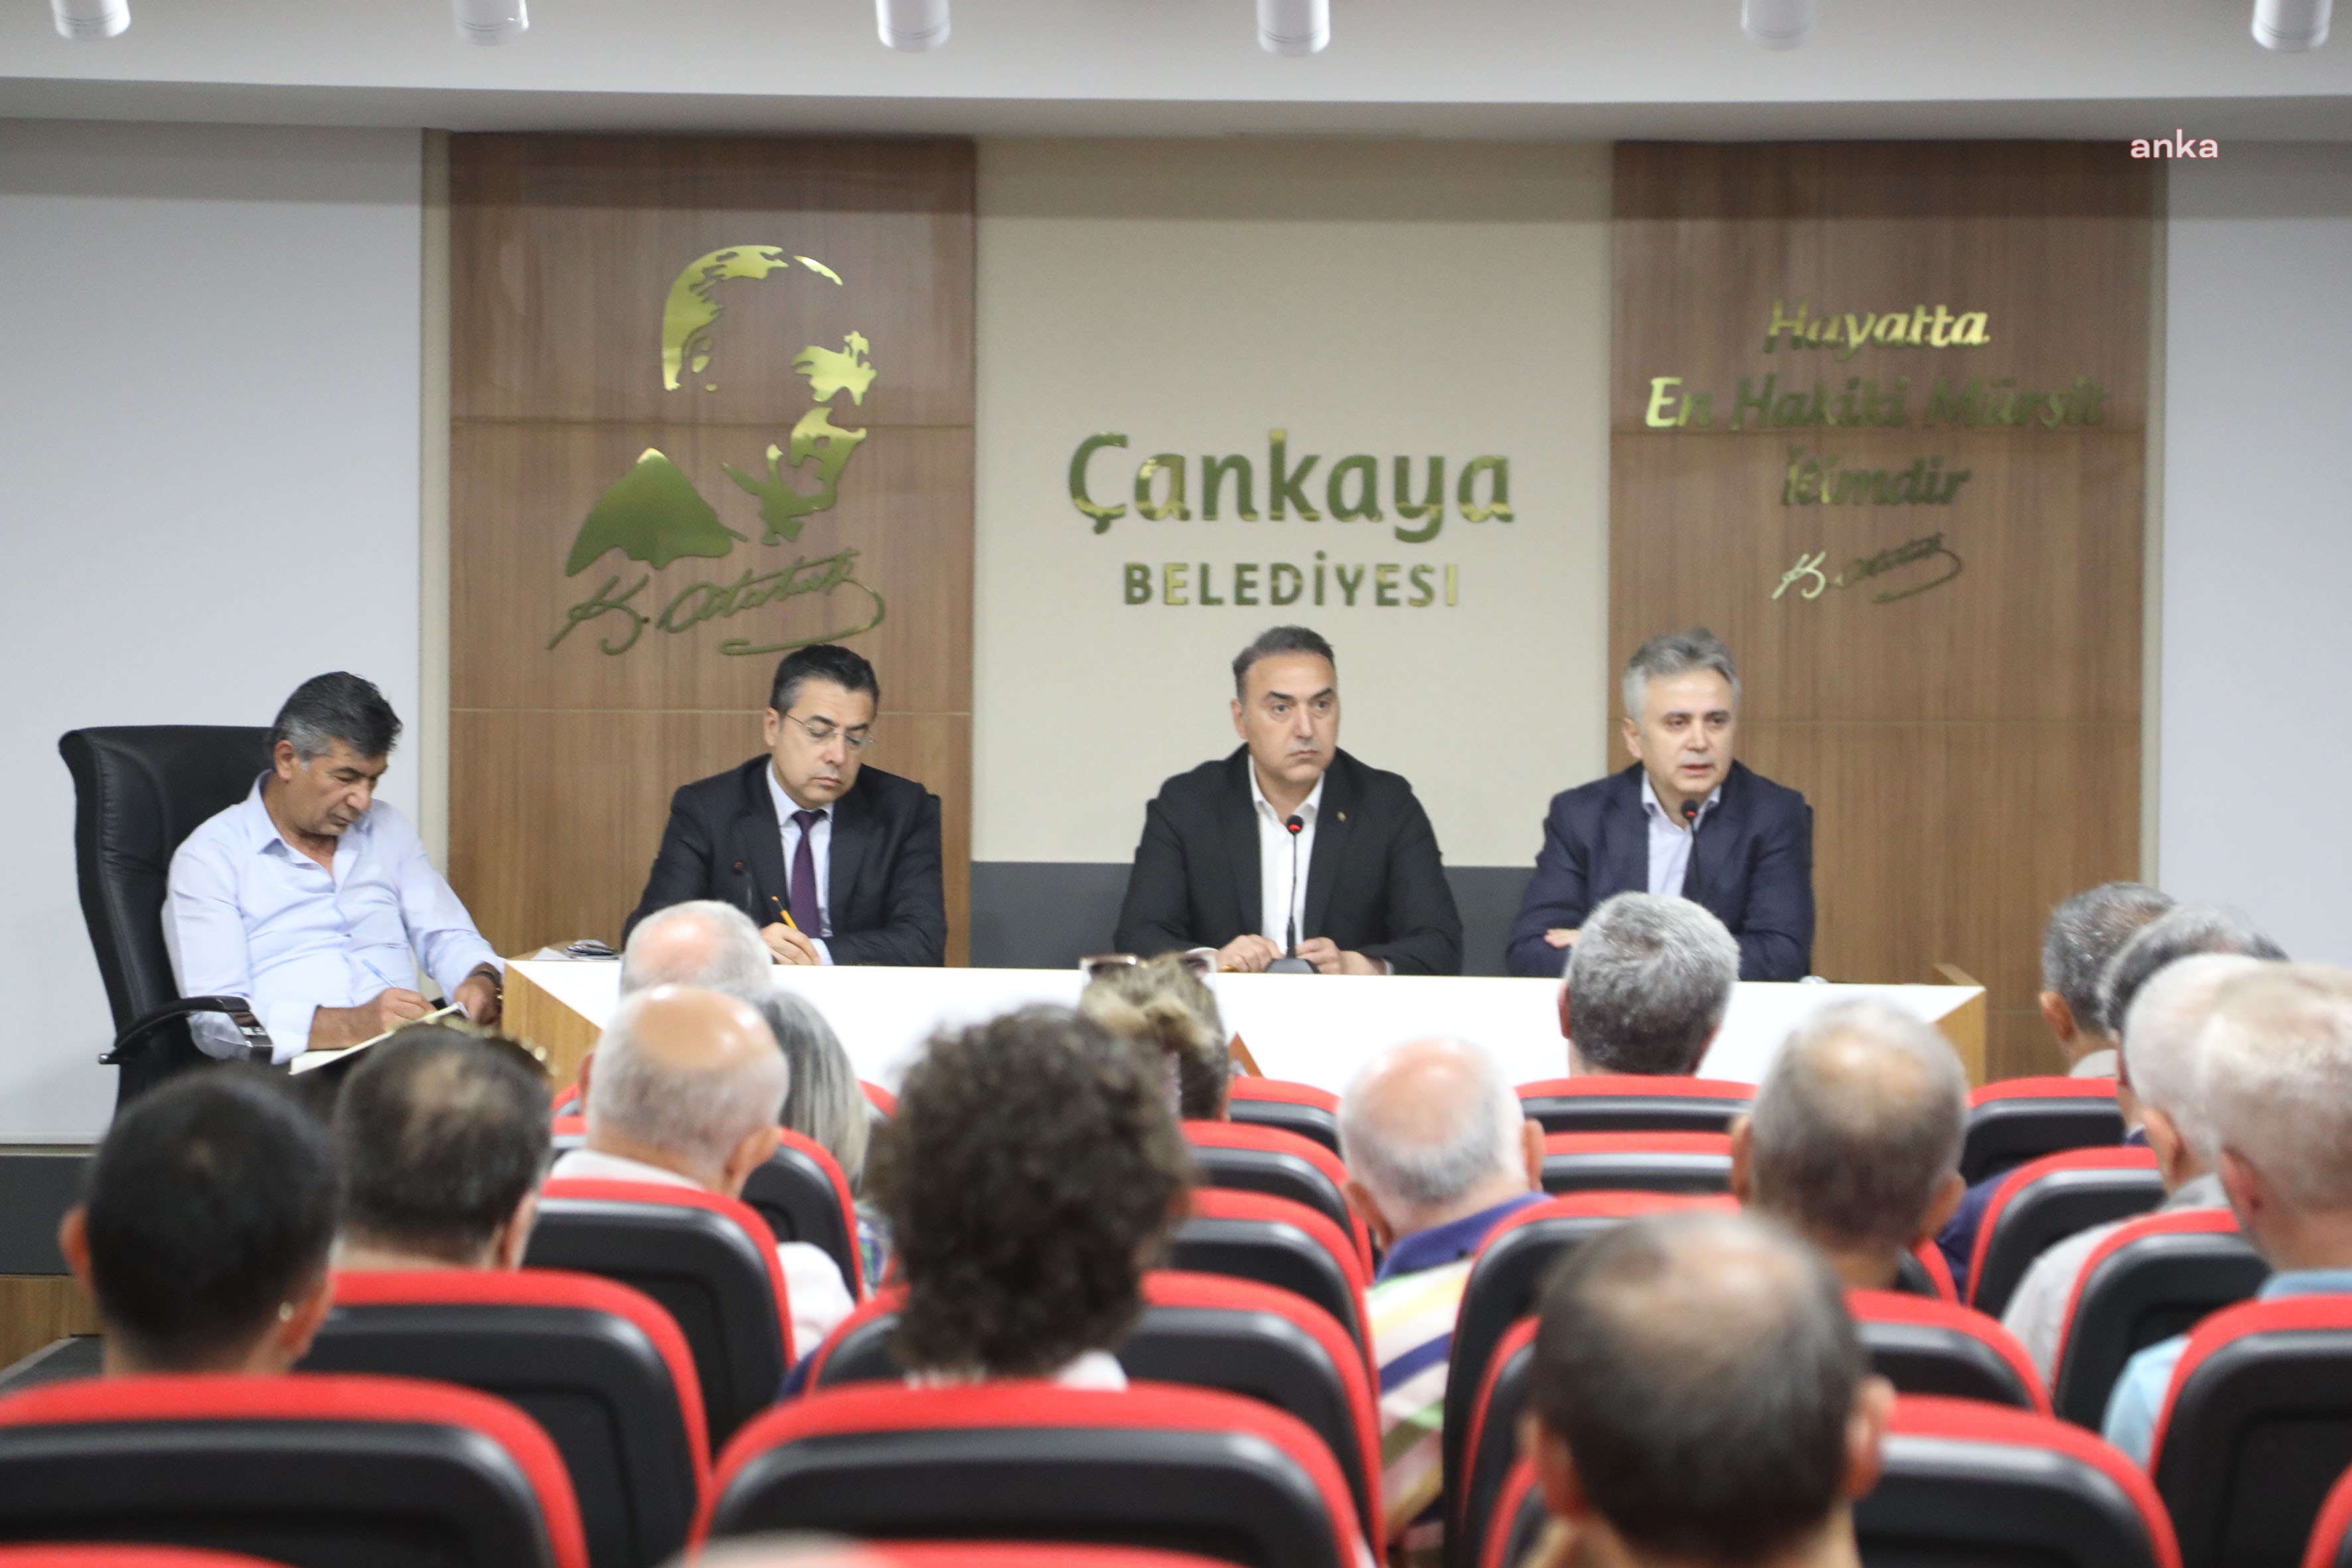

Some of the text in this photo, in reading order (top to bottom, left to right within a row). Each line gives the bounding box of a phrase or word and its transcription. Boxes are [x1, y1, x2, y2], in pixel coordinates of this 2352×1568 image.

[1763, 300, 1991, 361] Hayatta
[1644, 376, 1715, 429] En
[1730, 372, 1912, 431] Hakiki
[1068, 429, 1514, 544] Çankaya
